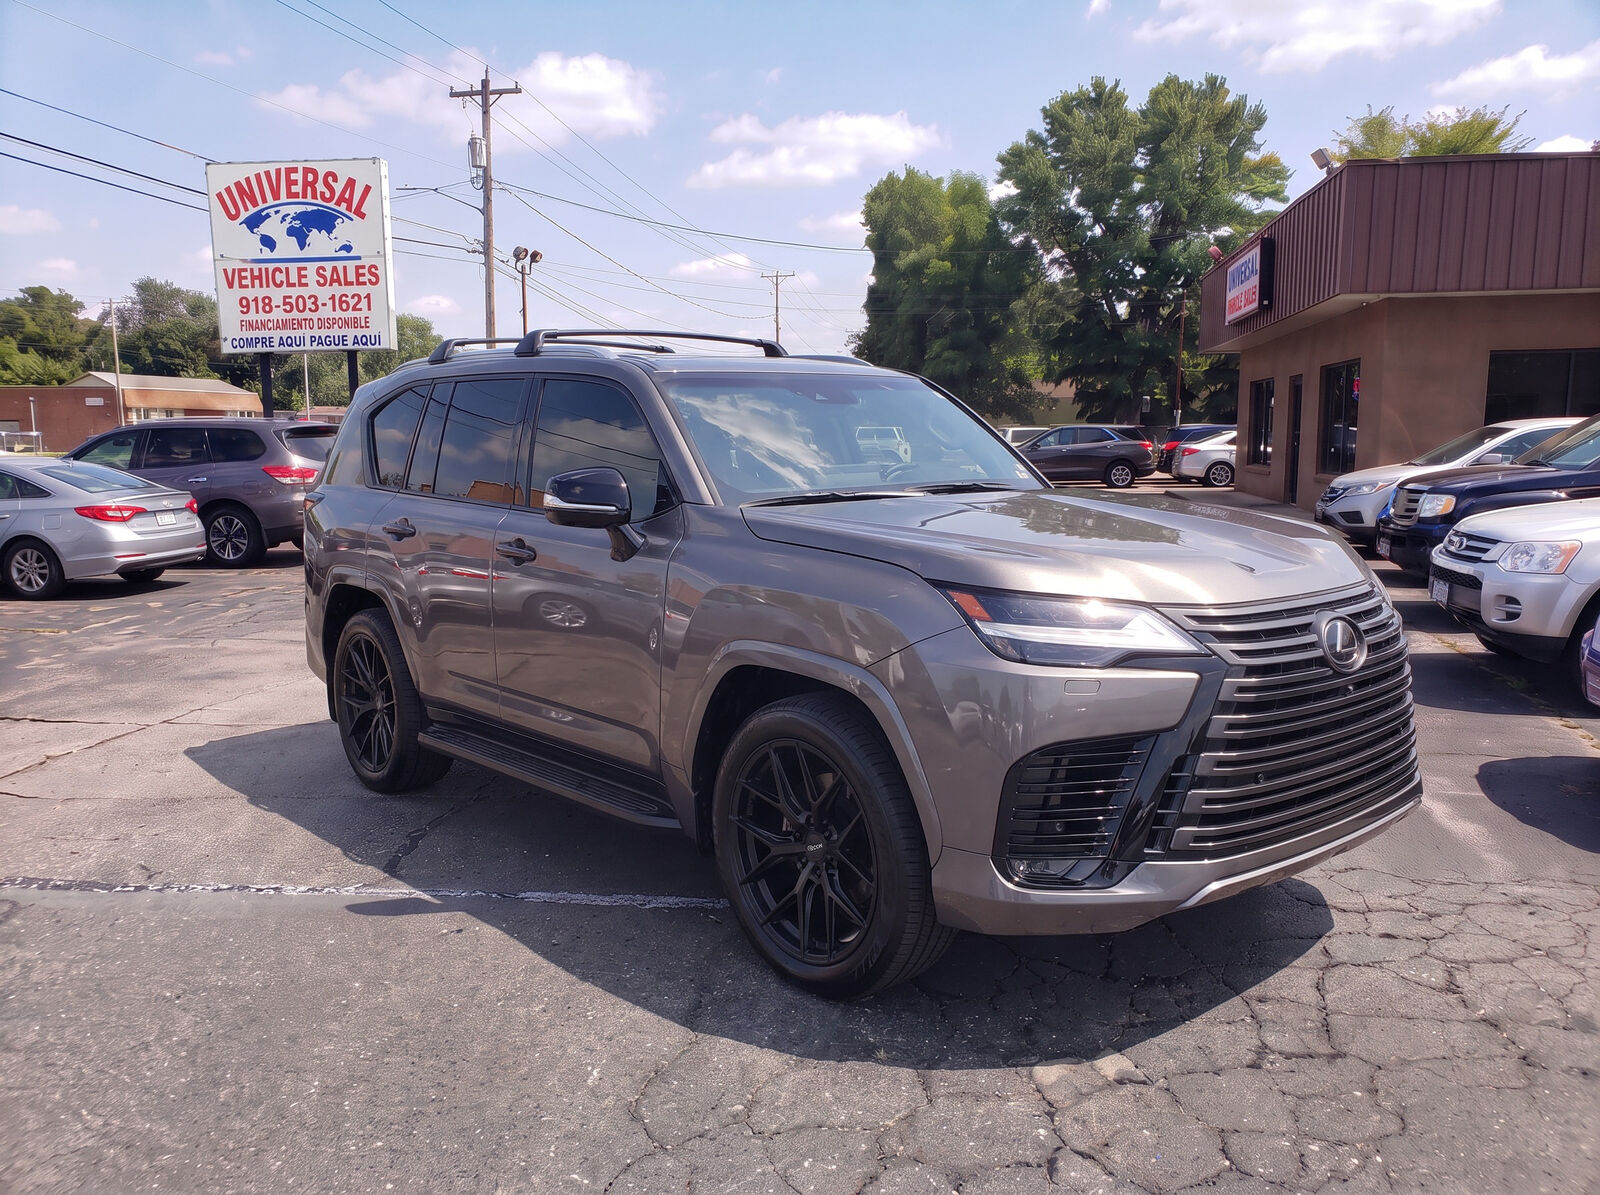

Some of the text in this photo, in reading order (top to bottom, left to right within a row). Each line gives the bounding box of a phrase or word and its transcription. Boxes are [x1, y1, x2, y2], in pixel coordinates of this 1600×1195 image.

[215, 166, 372, 222] UNIVERSAL
[222, 264, 380, 289] VEHICLE SALES
[238, 292, 372, 315] 918-503-1621
[240, 316, 370, 332] FINANCIAMIENTO DISPONIBLE
[231, 331, 381, 349] COMPRE AQUÍ PAGUE AQUÍ
